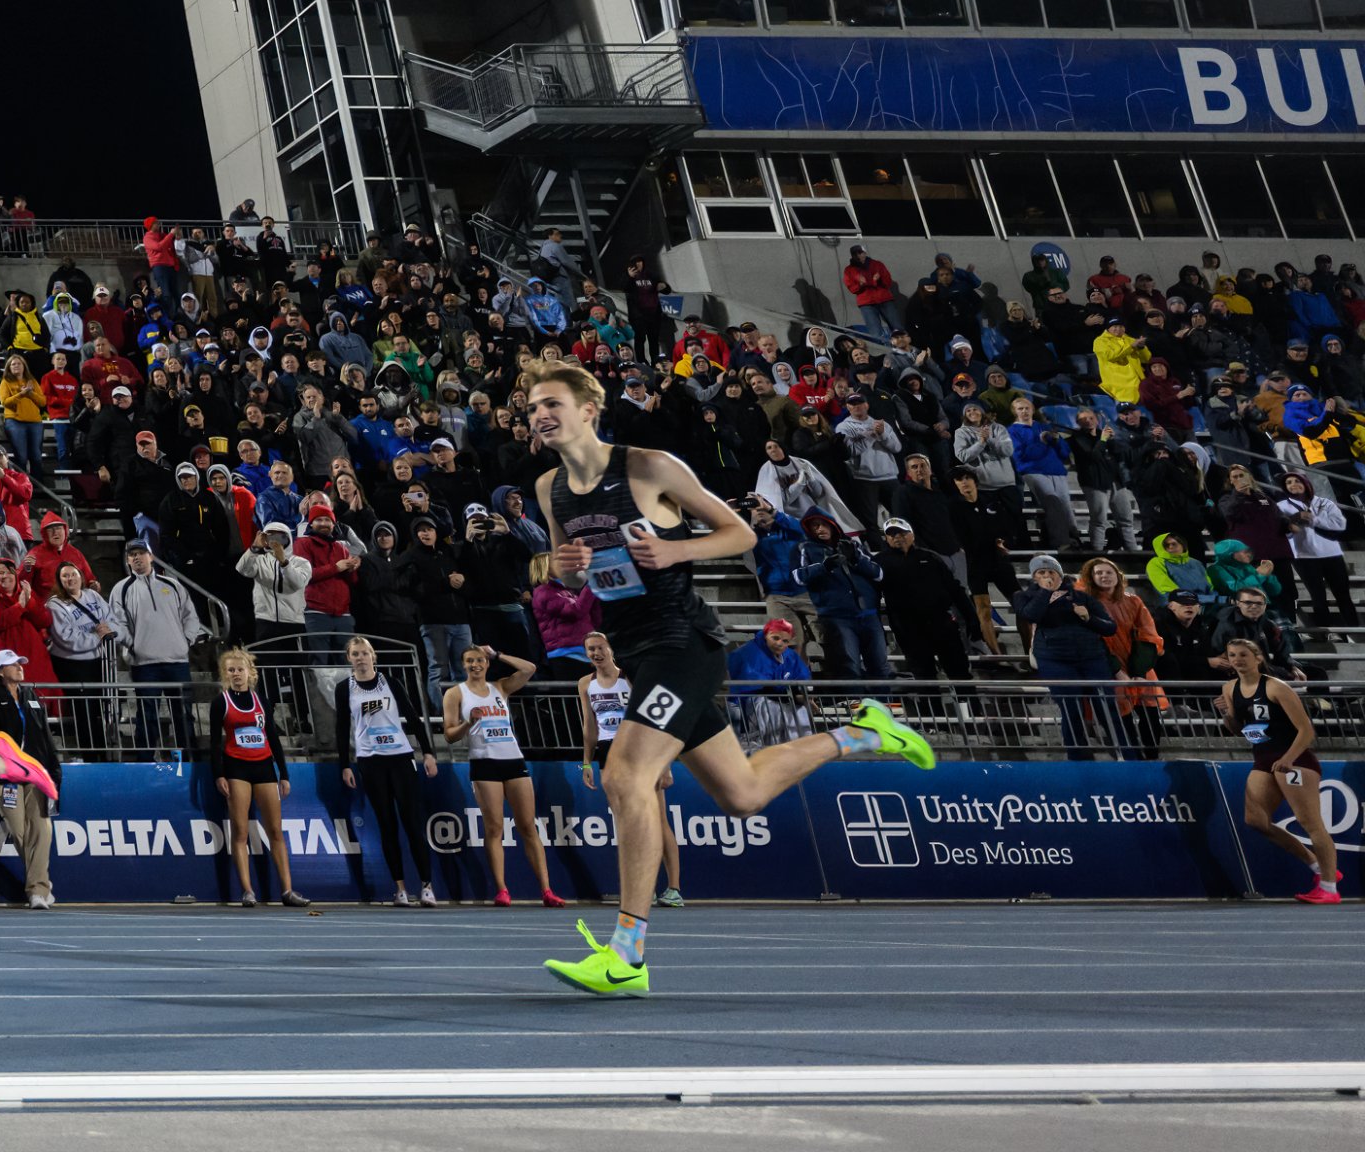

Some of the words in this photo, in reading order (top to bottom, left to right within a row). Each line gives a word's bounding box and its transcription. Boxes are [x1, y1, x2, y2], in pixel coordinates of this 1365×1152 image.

[593, 569, 627, 588] 803
[646, 691, 675, 721] 8
[1256, 705, 1266, 720] 2
[1288, 769, 1300, 785] 2
[916, 793, 1088, 830] UnityPoint
[1091, 793, 1197, 824] Health
[53, 819, 186, 857] DELTA
[928, 841, 978, 865] Des
[983, 841, 1074, 865] Moines
